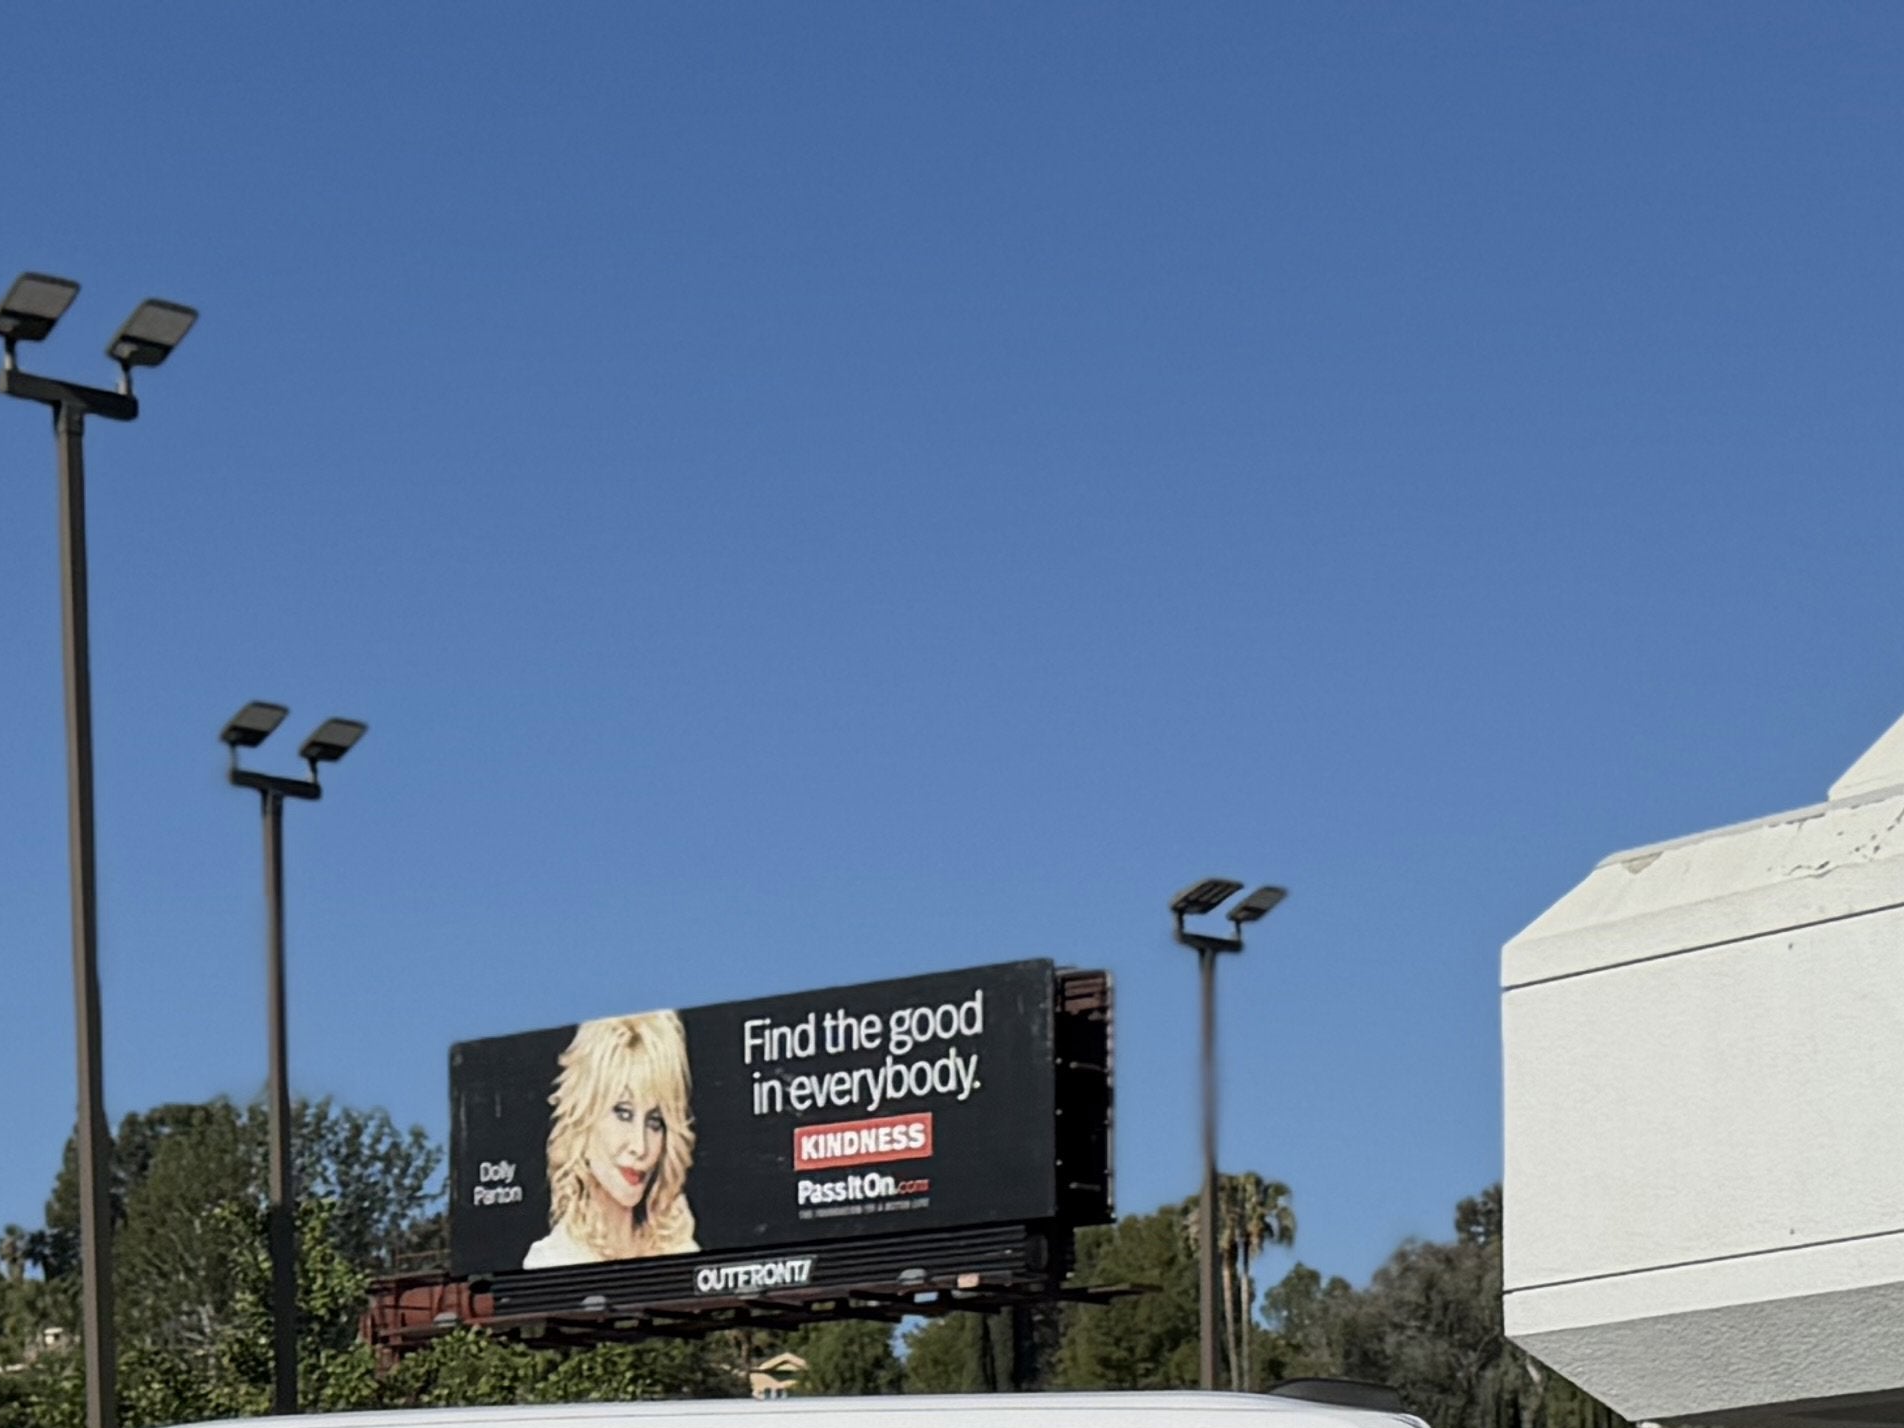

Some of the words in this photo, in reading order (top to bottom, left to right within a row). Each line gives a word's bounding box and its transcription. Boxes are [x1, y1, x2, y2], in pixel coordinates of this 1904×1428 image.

[744, 1012, 816, 1064] Find
[823, 1009, 882, 1053] the
[889, 989, 983, 1055] good
[752, 1071, 783, 1115] in
[790, 1046, 981, 1111] everybody.
[801, 1122, 926, 1160] KINDNESS
